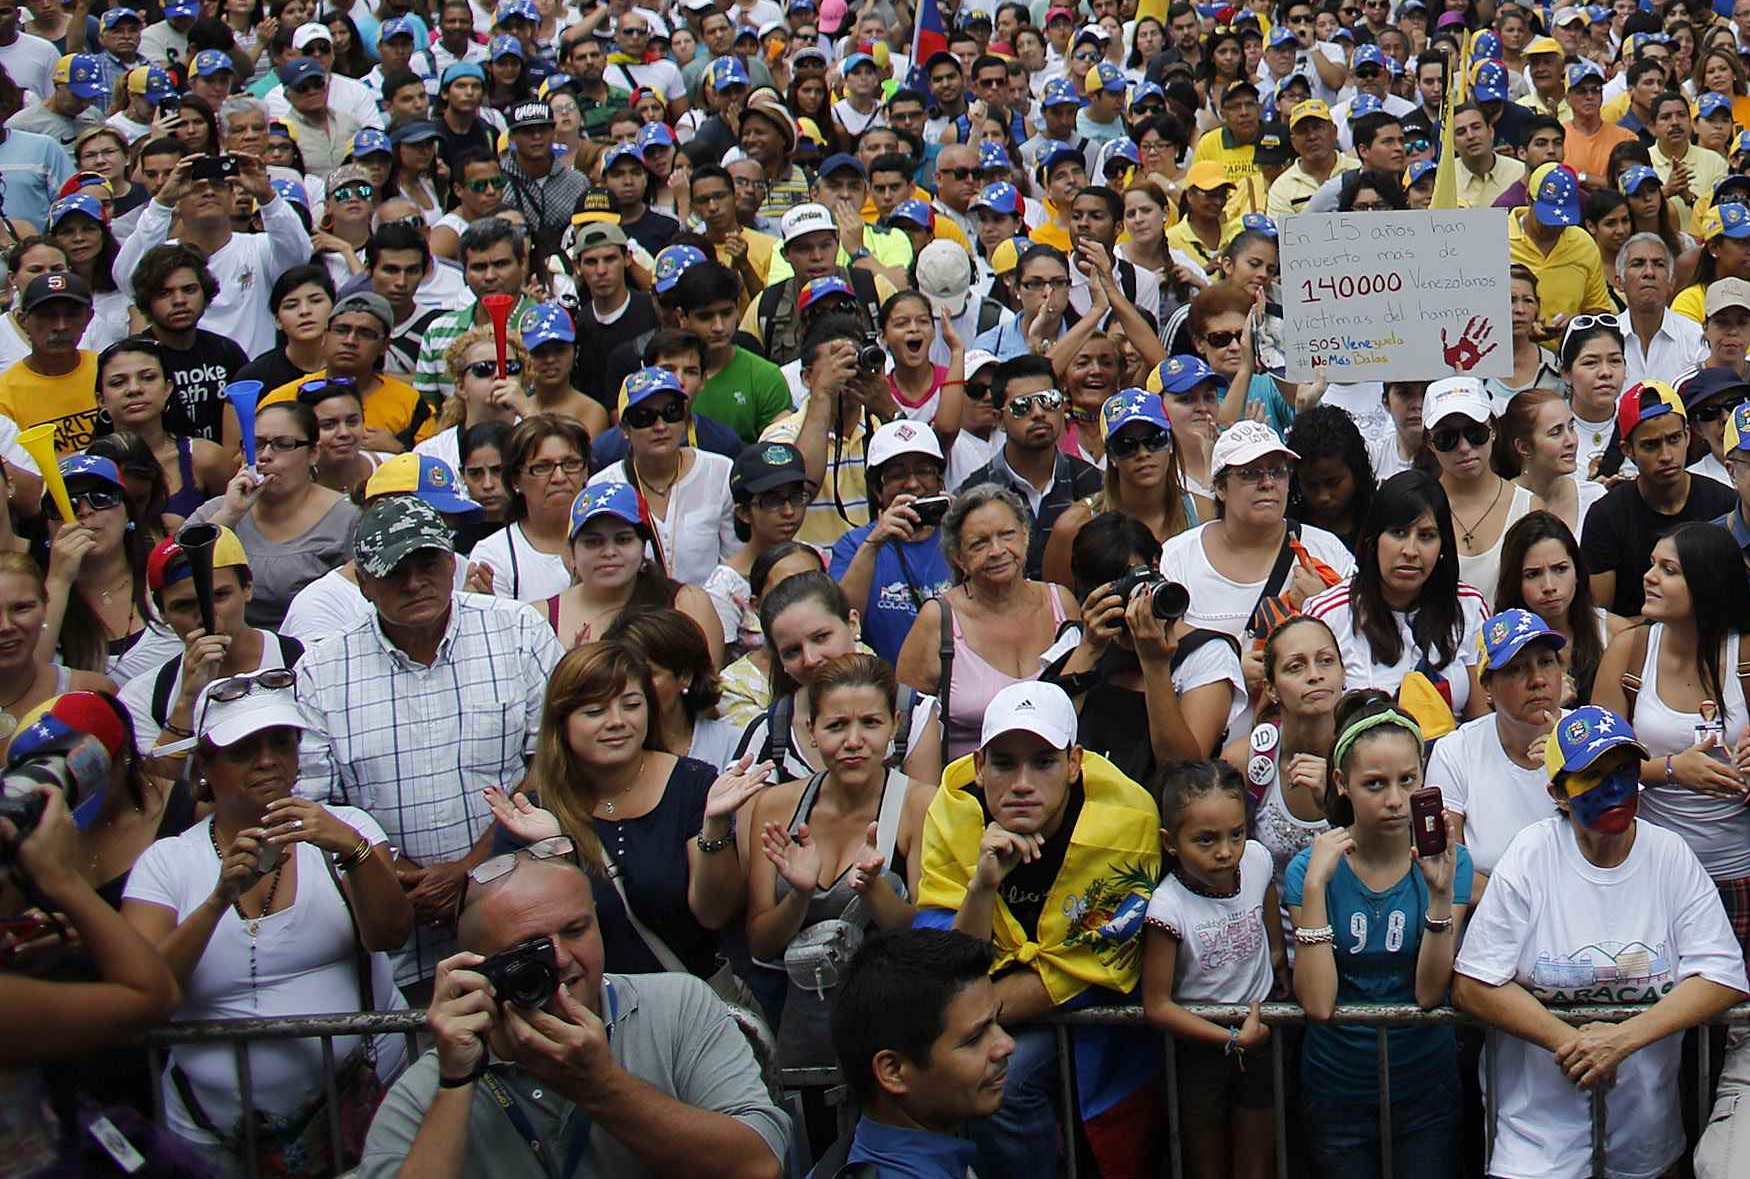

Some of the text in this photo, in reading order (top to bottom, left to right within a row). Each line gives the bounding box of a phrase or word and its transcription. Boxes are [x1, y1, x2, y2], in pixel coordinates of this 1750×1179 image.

[1283, 215, 1466, 246] En 15 años han
[1288, 247, 1361, 271] muerto
[1301, 272, 1402, 303] 140000
[1384, 300, 1404, 323] del
[1418, 300, 1471, 324] hampa
[175, 363, 227, 386] moke
[179, 384, 208, 405] eth
